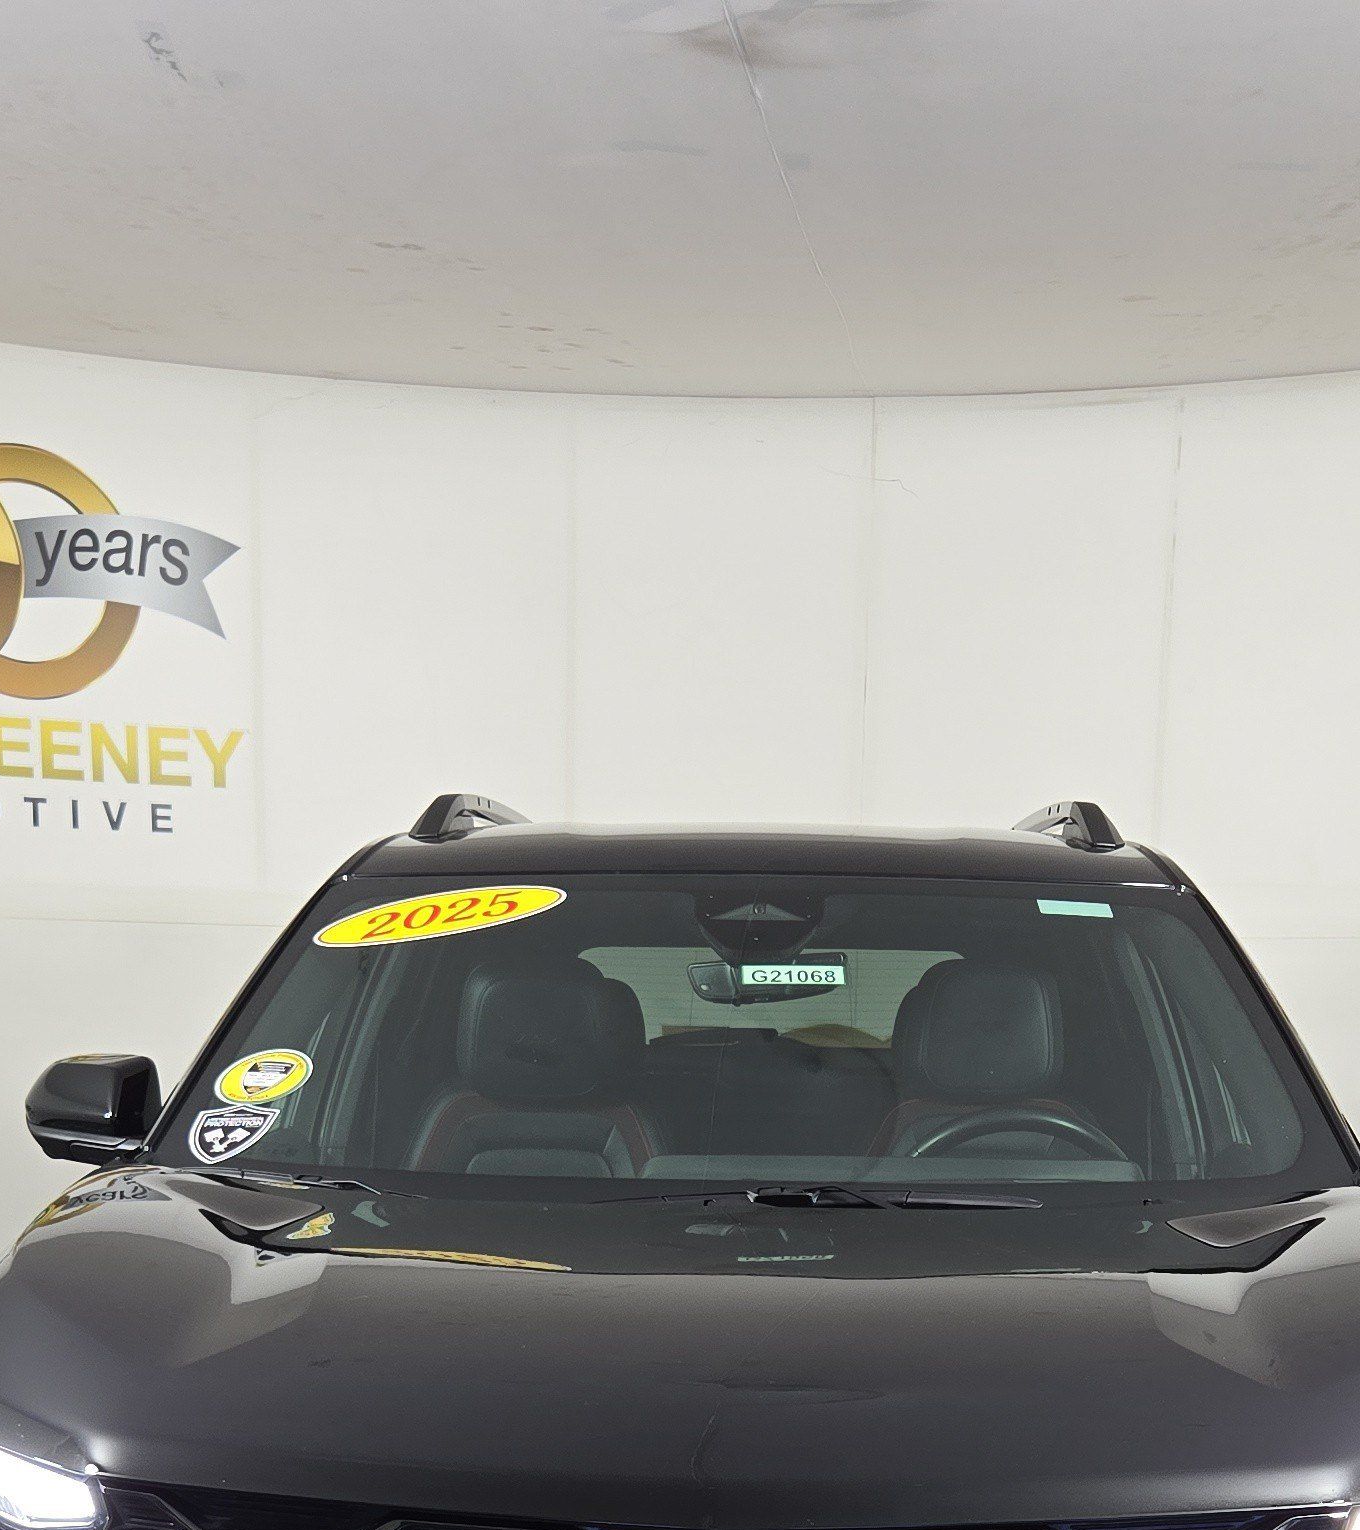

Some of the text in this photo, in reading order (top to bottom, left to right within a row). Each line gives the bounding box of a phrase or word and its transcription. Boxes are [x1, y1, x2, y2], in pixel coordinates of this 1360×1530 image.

[34, 527, 190, 587] years
[360, 890, 523, 941] 2025
[751, 969, 836, 983] G21068
